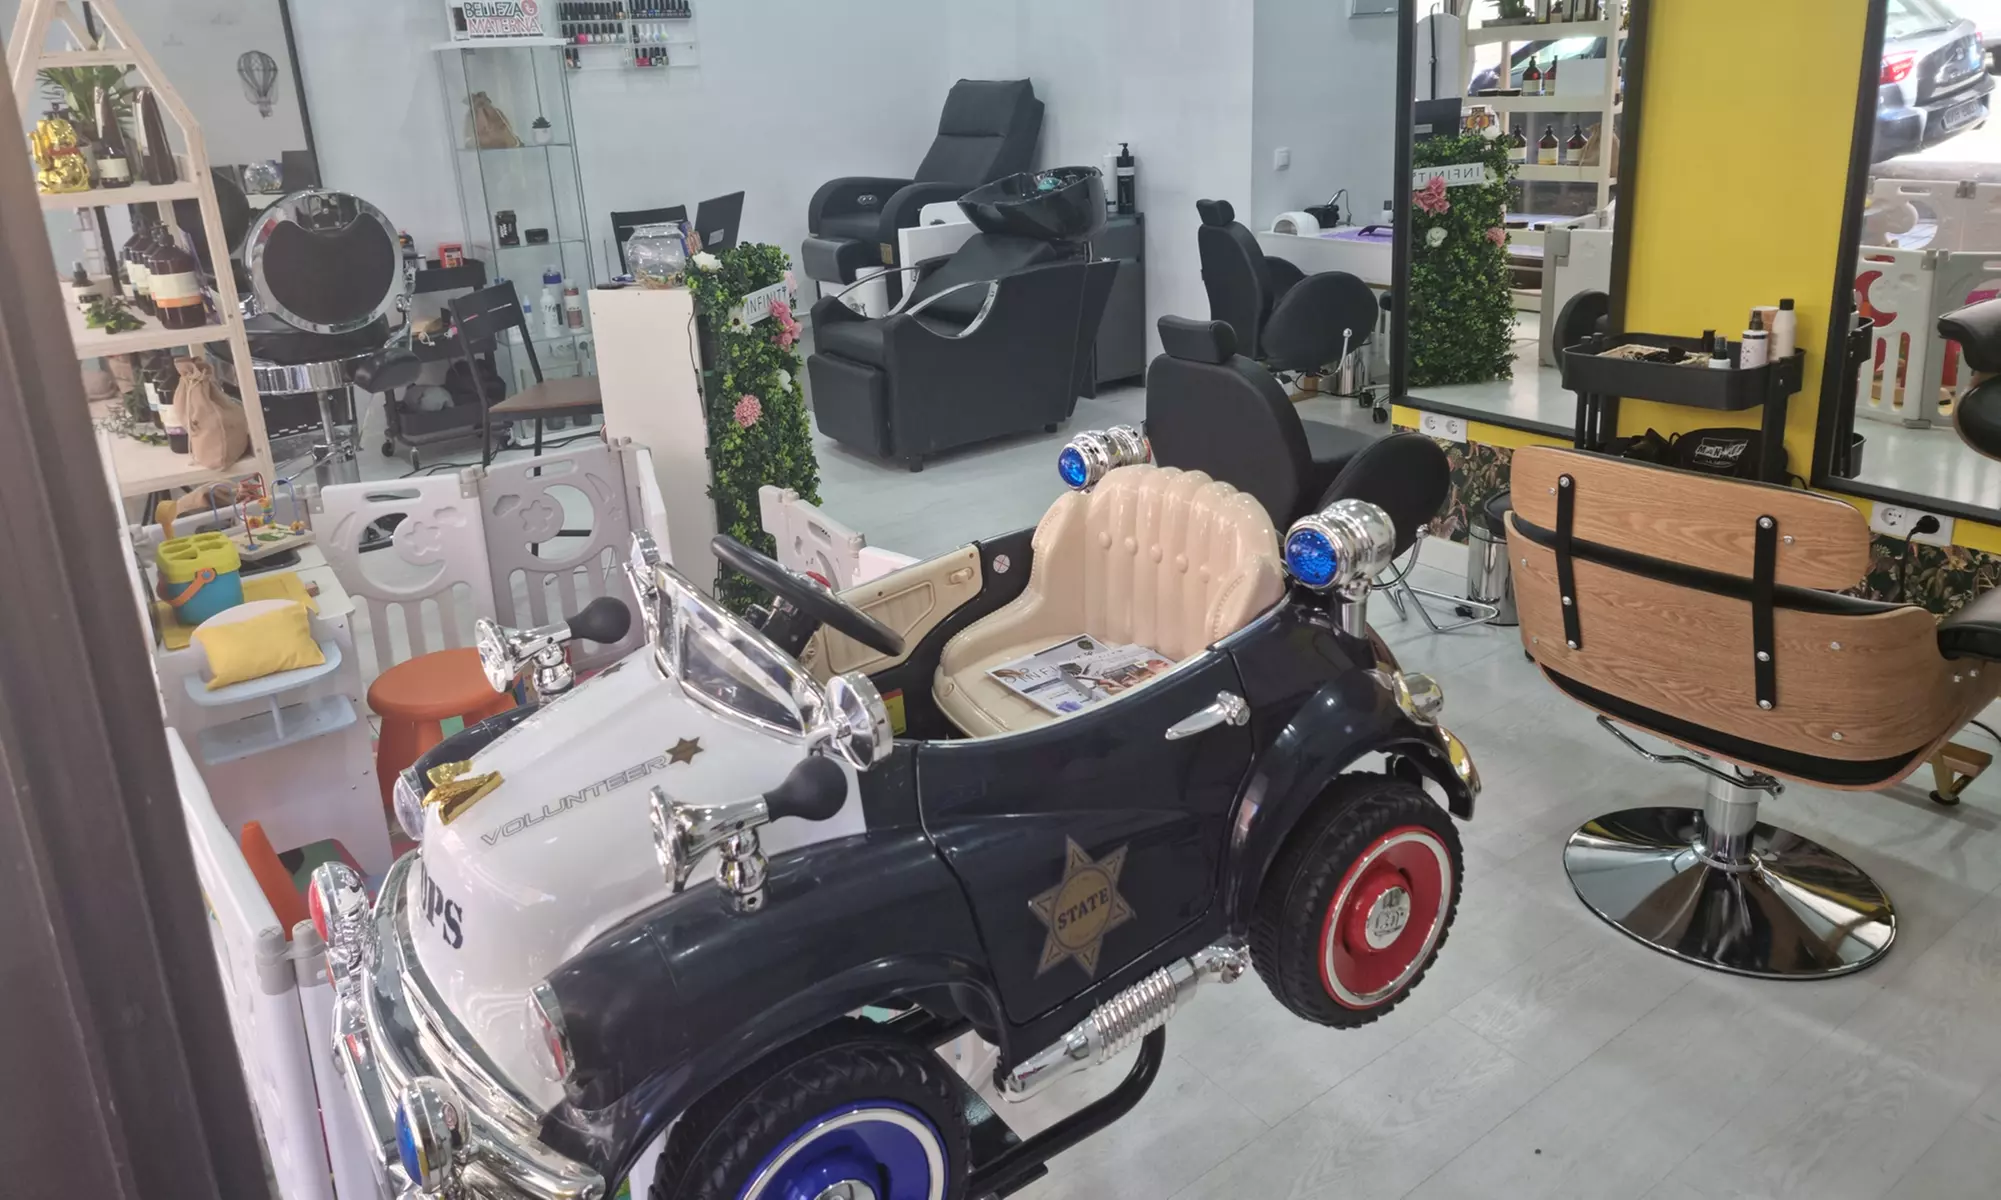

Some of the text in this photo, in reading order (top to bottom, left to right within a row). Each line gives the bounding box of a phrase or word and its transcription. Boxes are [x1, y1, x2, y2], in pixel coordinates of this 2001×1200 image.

[463, 2, 524, 18] BELLEZA
[467, 17, 543, 35] MATERNA
[480, 755, 669, 846] VOLUNTEER
[1058, 887, 1109, 931] STATE
